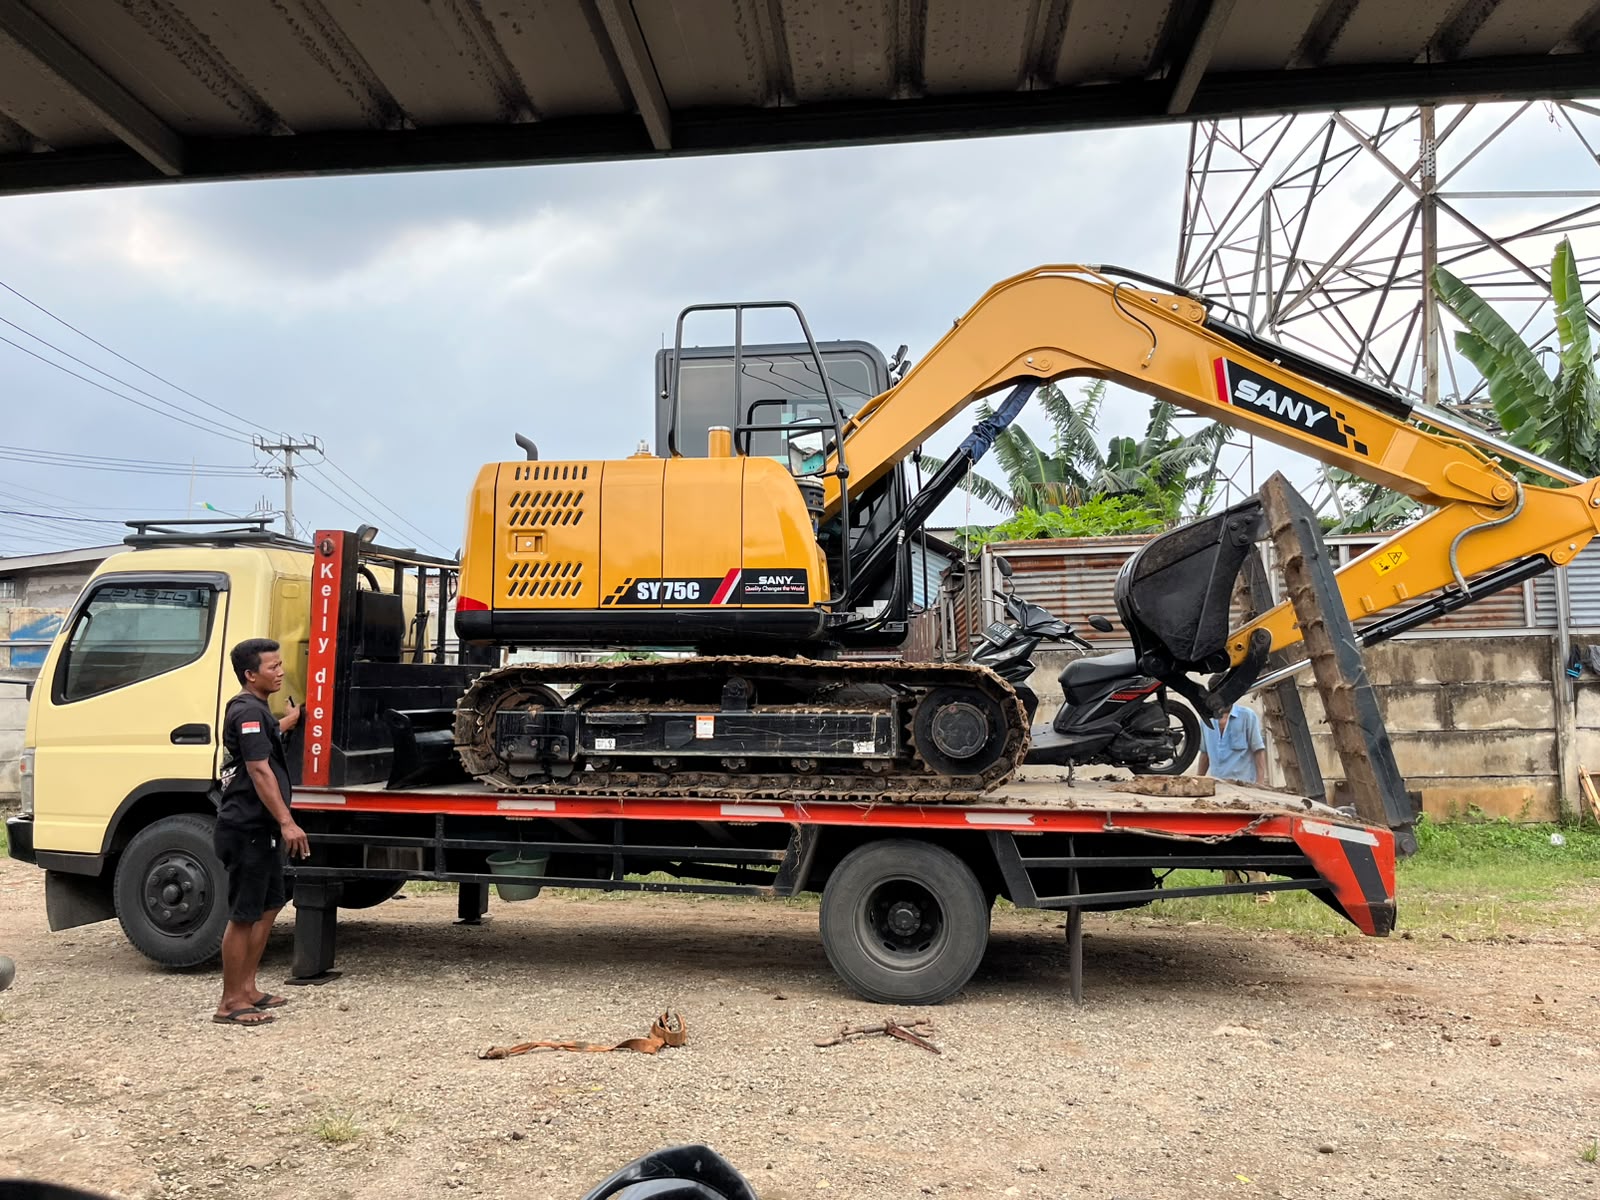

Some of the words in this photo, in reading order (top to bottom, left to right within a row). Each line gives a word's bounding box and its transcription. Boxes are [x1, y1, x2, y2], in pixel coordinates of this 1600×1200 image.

[1234, 379, 1328, 428] SANY
[758, 575, 793, 585] SANY
[318, 563, 334, 654] Kelly
